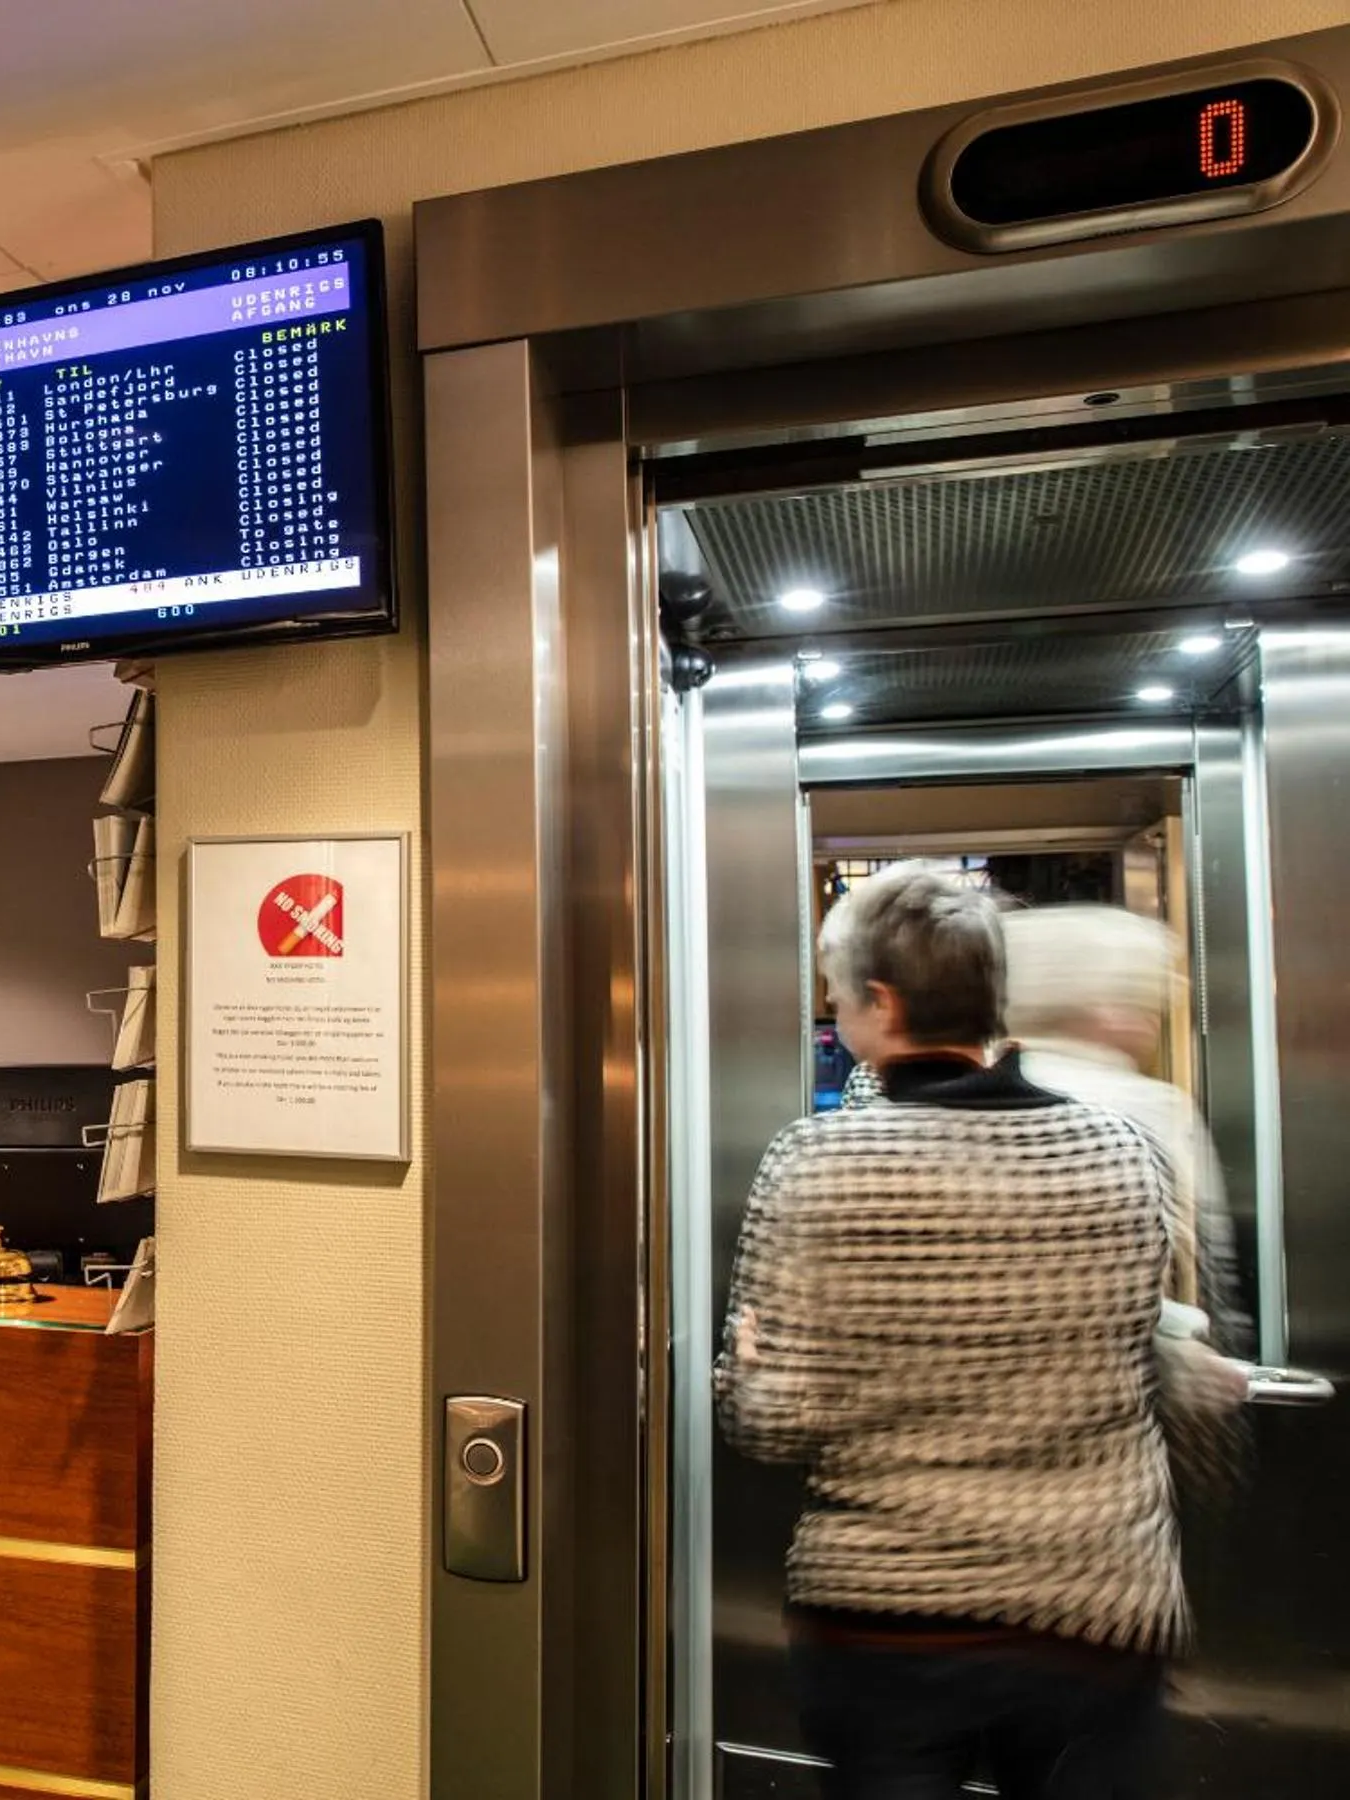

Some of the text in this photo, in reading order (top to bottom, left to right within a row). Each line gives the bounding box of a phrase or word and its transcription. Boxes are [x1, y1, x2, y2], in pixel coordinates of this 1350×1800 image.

[1200, 100, 1244, 177] 0
[55, 301, 90, 315] ons
[108, 291, 130, 305] 28
[148, 282, 185, 297] nov
[231, 250, 343, 281] 08:10:55
[232, 278, 345, 308] UDENRIGS
[232, 297, 315, 322] AFGANG
[44, 365, 174, 395] London/Lhr
[234, 338, 317, 362] Closed
[44, 376, 174, 407] Sandefjord
[235, 352, 317, 375] Closed
[56, 365, 92, 379] TIL
[45, 408, 67, 420] St
[84, 385, 217, 414] Petersburg
[235, 365, 318, 389] Closed
[45, 409, 147, 434] Hurghada
[235, 379, 318, 402] Closed
[46, 425, 134, 447] Bologna
[236, 393, 319, 416] Closed
[46, 432, 162, 460] Stuttgart
[237, 407, 319, 430] Closed
[46, 449, 148, 472] Hannover
[237, 421, 320, 444] Closed
[46, 460, 163, 486] Stavanger
[237, 435, 321, 457] Closed
[46, 478, 136, 499] Vilnius
[237, 449, 321, 471] Closed
[46, 493, 123, 512] Warsaw
[238, 463, 321, 485] Closed
[47, 501, 148, 525] Helsinki
[239, 477, 322, 498] Closed
[48, 518, 137, 537] Tallinn
[239, 491, 337, 512] Closing
[48, 537, 97, 551] Oslo
[239, 505, 323, 526] Closed
[48, 547, 125, 564] Bergen
[239, 528, 265, 539] To
[284, 520, 338, 535] gate
[48, 559, 125, 577] Gdansk
[240, 534, 339, 553] Closing
[48, 568, 166, 591] Amsterdam
[241, 548, 339, 567] Closing
[184, 573, 223, 589] ANK
[241, 557, 355, 582] UDENRIGS
[157, 603, 195, 619] 600
[273, 891, 295, 912] NO
